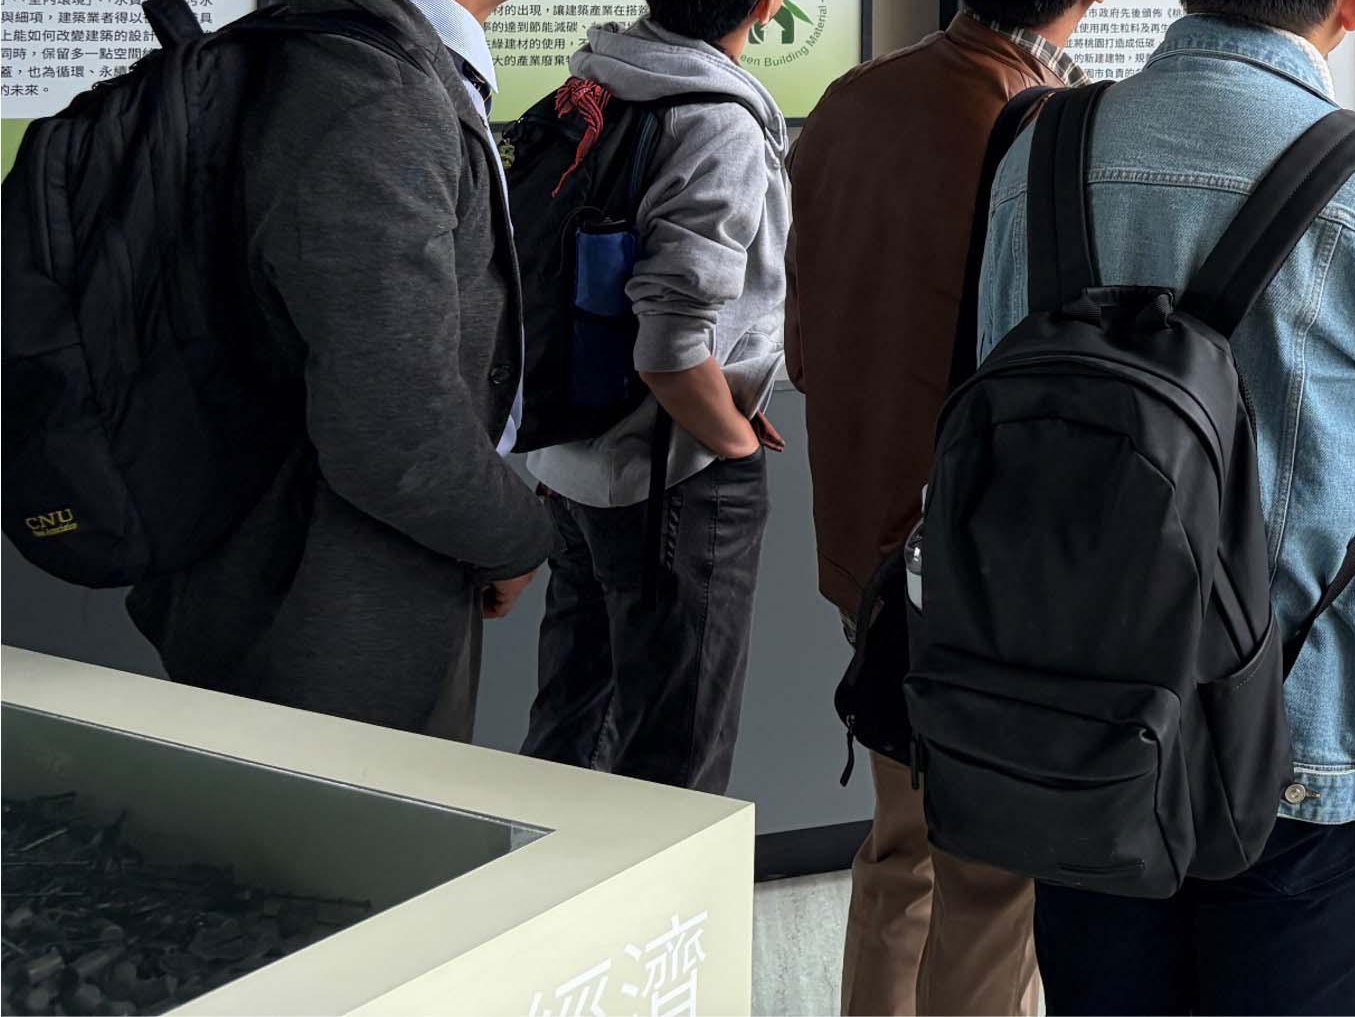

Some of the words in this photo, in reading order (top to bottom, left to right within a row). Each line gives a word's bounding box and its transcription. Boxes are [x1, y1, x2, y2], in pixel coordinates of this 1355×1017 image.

[488, 4, 649, 17] 材的出現，讓建築產業在搭
[1, 12, 151, 25] 與細項，建築業者得以
[764, 47, 810, 67] Building
[809, 5, 827, 49] Material
